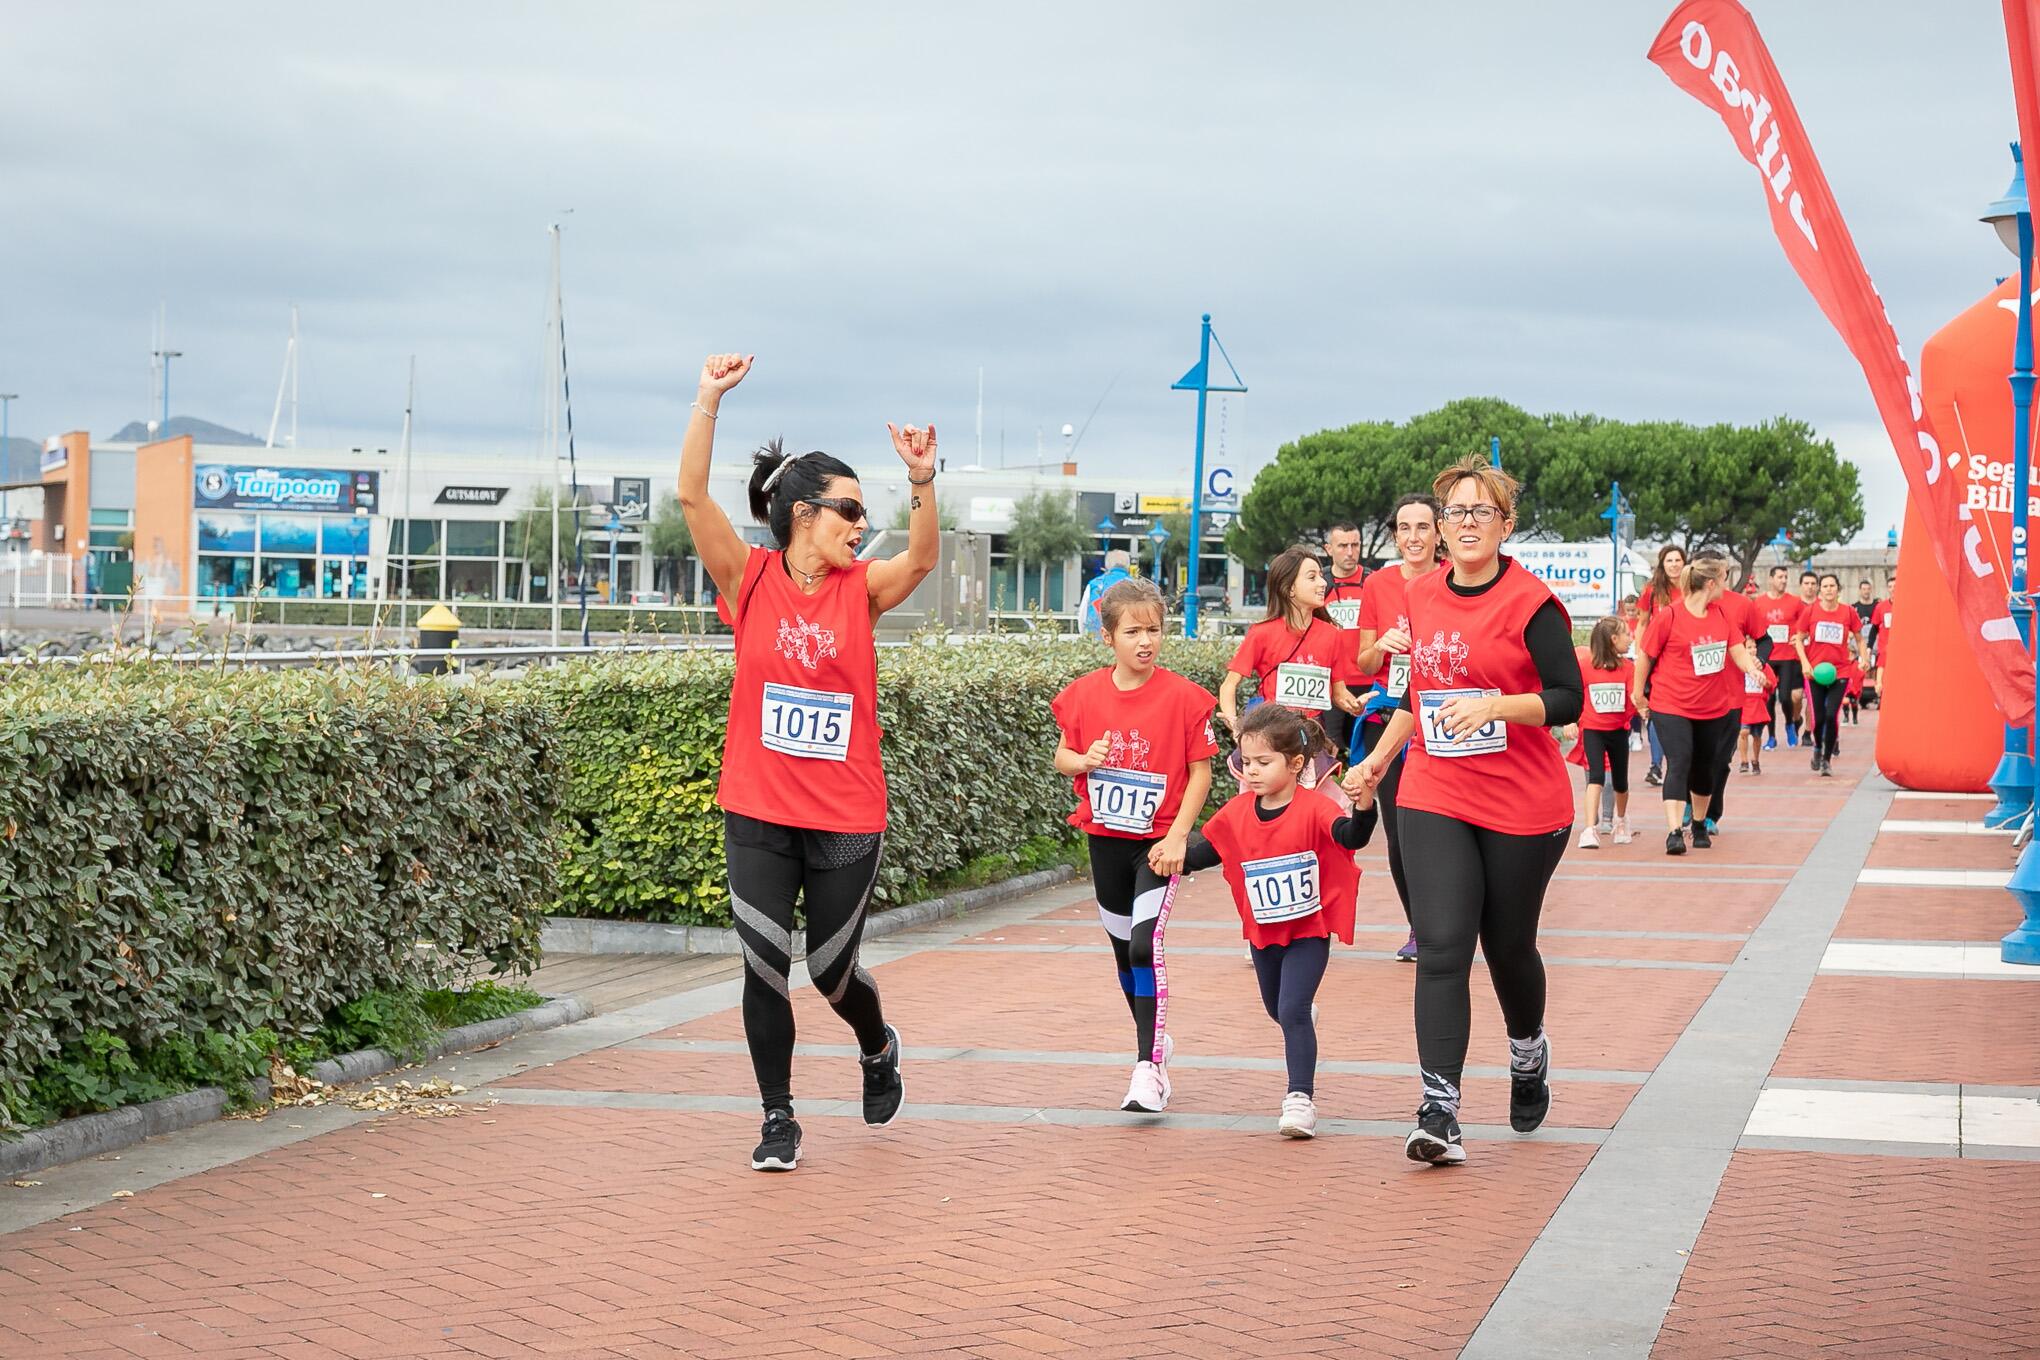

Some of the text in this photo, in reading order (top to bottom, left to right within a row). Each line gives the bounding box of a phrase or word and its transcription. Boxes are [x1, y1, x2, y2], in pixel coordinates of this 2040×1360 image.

[235, 472, 340, 502] Tarpoon
[1209, 469, 1232, 497] C
[1284, 676, 1325, 699] 2022
[1395, 667, 1411, 687] 2
[1594, 691, 1622, 705] 2007
[772, 705, 842, 743] 1015
[1095, 783, 1158, 819] 1015
[1252, 870, 1313, 907] 1015
